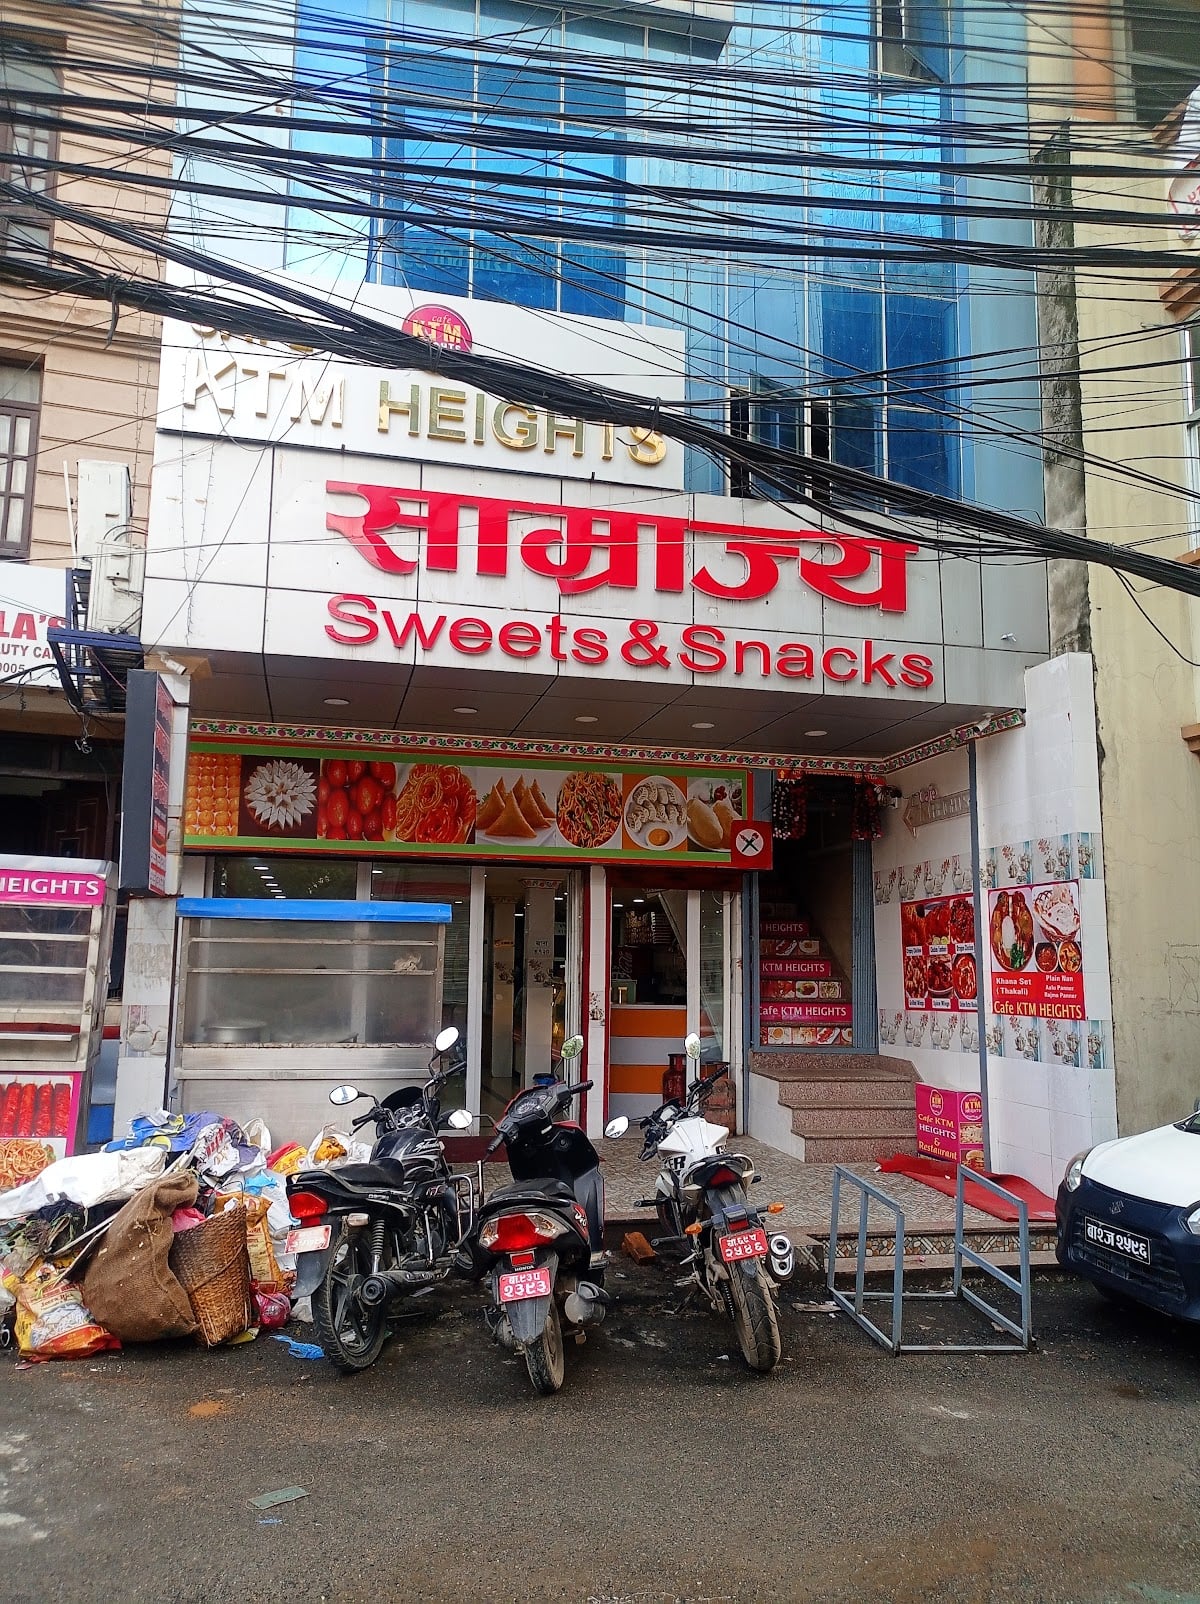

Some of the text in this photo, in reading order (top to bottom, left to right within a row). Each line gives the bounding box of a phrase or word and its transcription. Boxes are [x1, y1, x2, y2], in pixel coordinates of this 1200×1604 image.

[412, 320, 461, 343] KTM
[183, 350, 345, 428] KTM
[325, 480, 919, 613] साम्राज्य
[766, 923, 804, 932] HEIGHTS
[762, 963, 825, 972] KTM HEIGHTS
[1045, 974, 1060, 982] Plain
[781, 1007, 802, 1016] KTM
[805, 1007, 847, 1016] HEIGHTS
[993, 1001, 1014, 1014] Cafe
[1016, 1002, 1037, 1015] KTM
[1039, 1003, 1083, 1019] HEIGHTS
[918, 1113, 955, 1129] Cafe KTM
[919, 1123, 957, 1140] HEIGHTS
[918, 1140, 957, 1161] Restaurant
